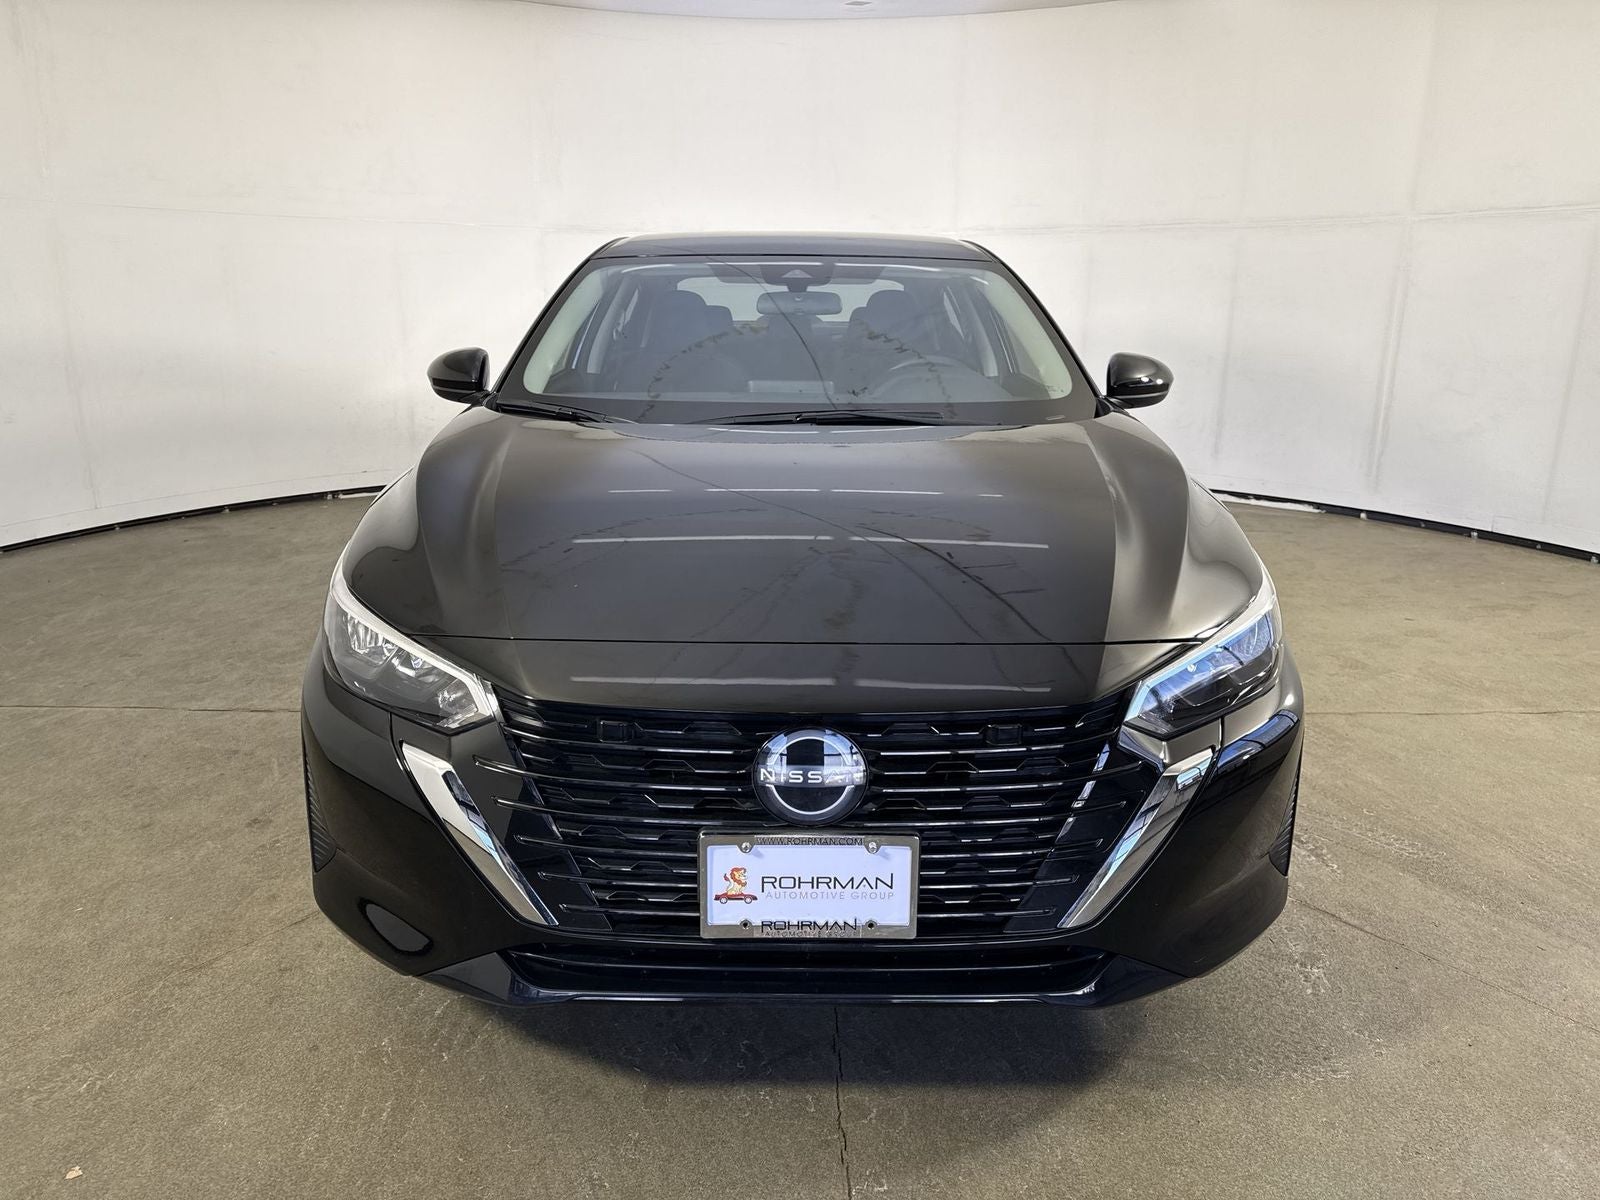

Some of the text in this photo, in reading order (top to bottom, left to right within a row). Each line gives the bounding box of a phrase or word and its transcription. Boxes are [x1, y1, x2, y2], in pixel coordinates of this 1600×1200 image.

[761, 873, 893, 893] ROHRMAN
[765, 891, 894, 900] AUTOMOTIVE GROUP
[761, 918, 857, 933] ROHRMAN
